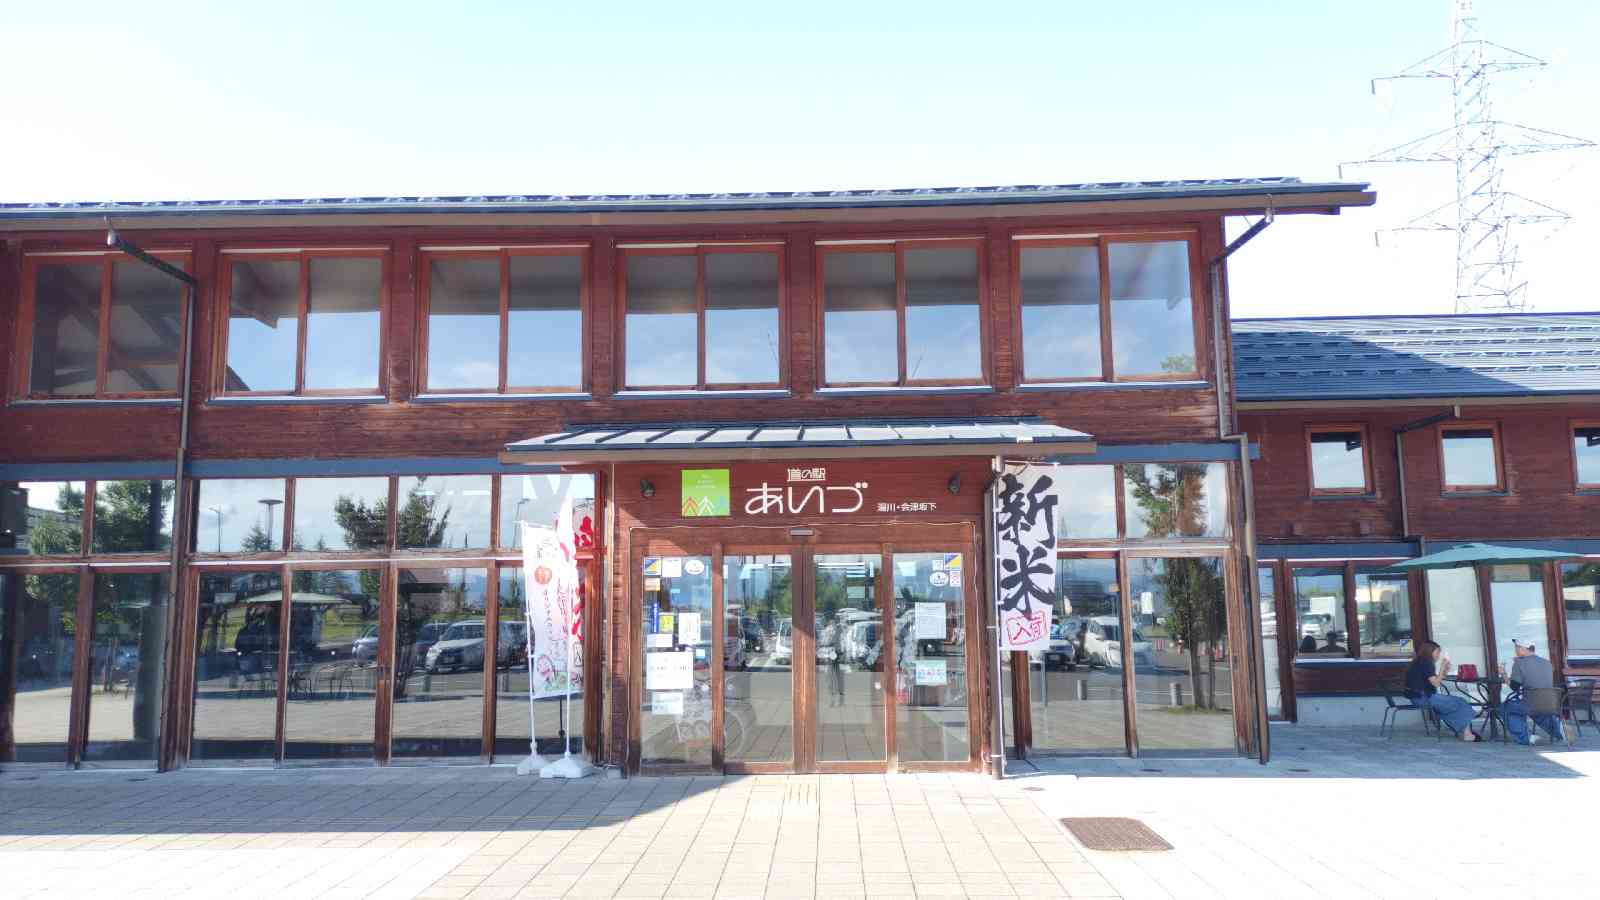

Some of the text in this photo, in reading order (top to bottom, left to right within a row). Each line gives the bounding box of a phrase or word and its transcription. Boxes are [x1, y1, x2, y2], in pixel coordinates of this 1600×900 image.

[787, 467, 826, 481] 道の駅
[744, 482, 869, 514] あいづ
[998, 473, 1058, 620] 新米
[1013, 615, 1043, 641] 入荷
